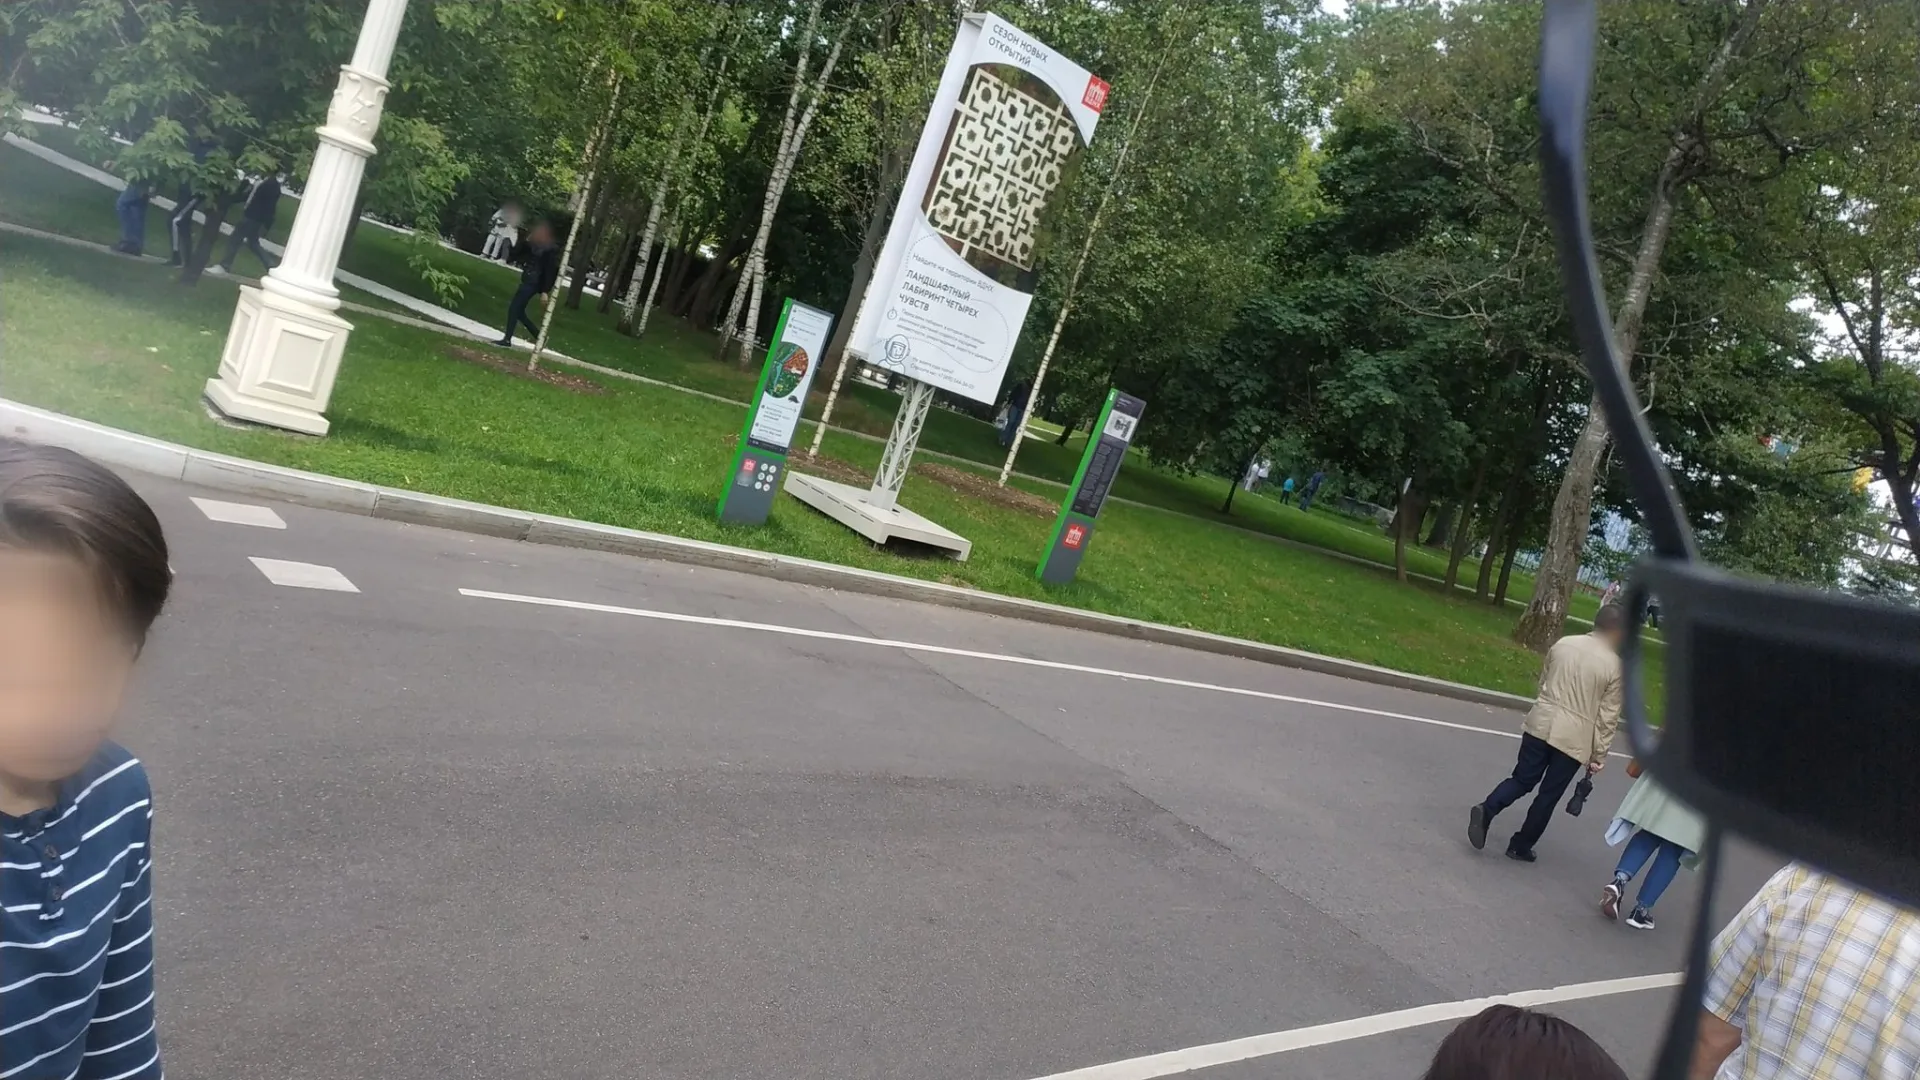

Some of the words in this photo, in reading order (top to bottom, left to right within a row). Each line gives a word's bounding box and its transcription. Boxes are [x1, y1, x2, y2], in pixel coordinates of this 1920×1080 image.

[988, 37, 1032, 67] ОТКРЫТИЙ
[993, 24, 1020, 44] СЕЗОН
[1019, 41, 1048, 63] НОВЫХ
[906, 270, 971, 300] ЛАНДШАФТНЫЙ
[913, 254, 938, 269] Найдите
[945, 268, 977, 285] территории
[978, 281, 994, 292] ВДНХ
[899, 294, 930, 311] ЧУВСТВ
[902, 282, 946, 305] ЛАБИРИНТ
[946, 299, 979, 318] ЧЕТЫРЕХ
